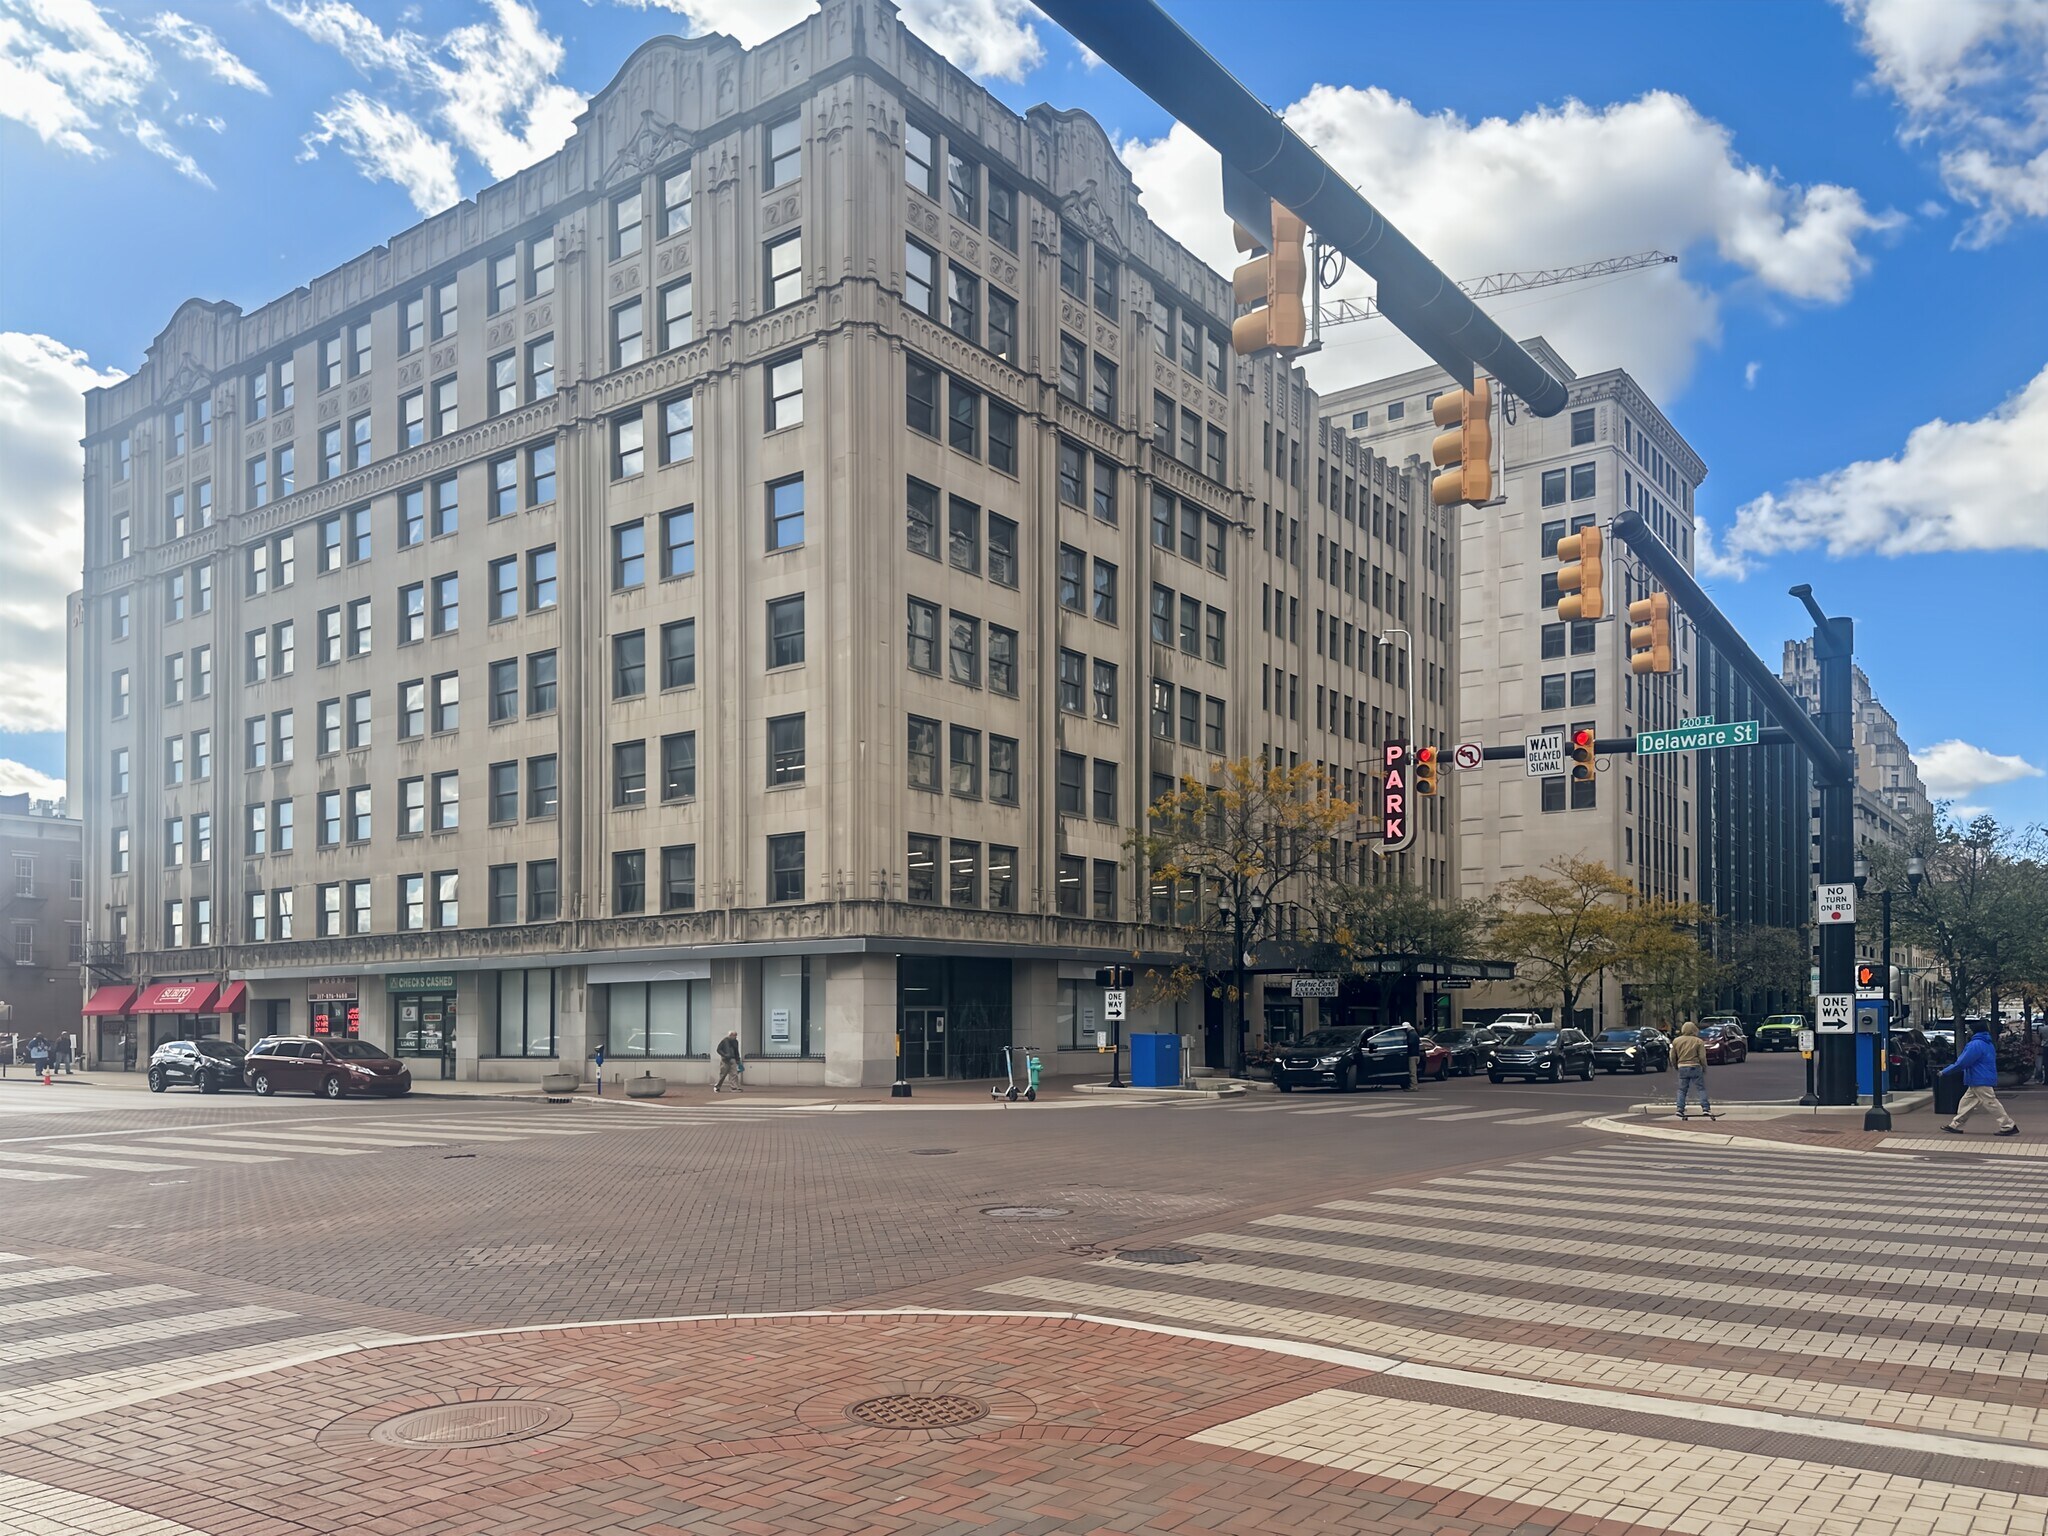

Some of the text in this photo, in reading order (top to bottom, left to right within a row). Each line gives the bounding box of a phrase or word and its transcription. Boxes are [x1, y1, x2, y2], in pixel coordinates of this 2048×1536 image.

[1682, 716, 1711, 728] 200 E
[1530, 737, 1559, 750] WAIT
[1642, 724, 1752, 752] Delaware St
[1529, 750, 1561, 761] DELAYED
[1531, 761, 1560, 772] SIGNAL
[1386, 746, 1404, 838] PARK
[1828, 887, 1844, 895] NO
[426, 976, 453, 987] CASHED
[1823, 998, 1848, 1007] ONE
[1822, 1008, 1848, 1017] WAY
